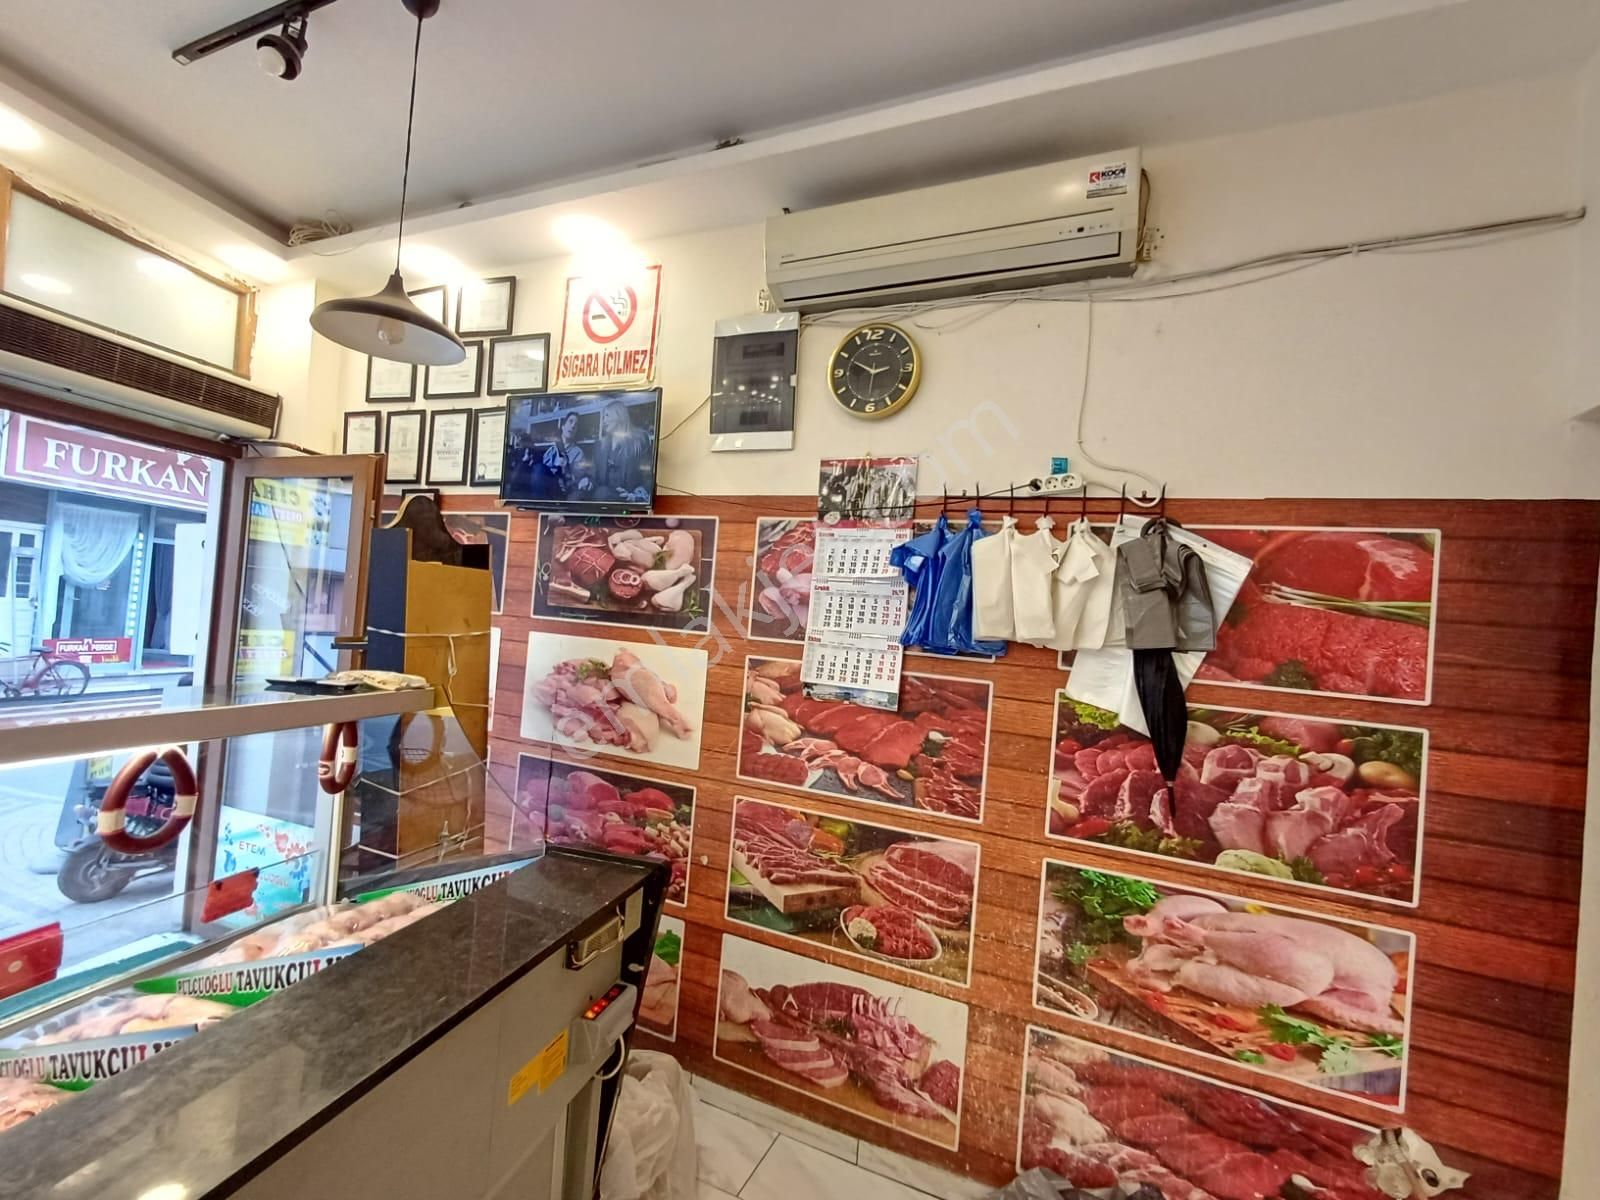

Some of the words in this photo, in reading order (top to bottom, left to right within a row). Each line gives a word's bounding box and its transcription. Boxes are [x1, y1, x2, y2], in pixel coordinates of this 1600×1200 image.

[862, 329, 884, 340] 12
[602, 347, 648, 380] İÇİLMEZ
[834, 369, 843, 378] 9
[903, 364, 913, 372] 3
[865, 403, 875, 412] 6
[43, 437, 208, 496] FURKAN
[60, 644, 89, 652] FURKAN
[239, 841, 266, 856] ETEM
